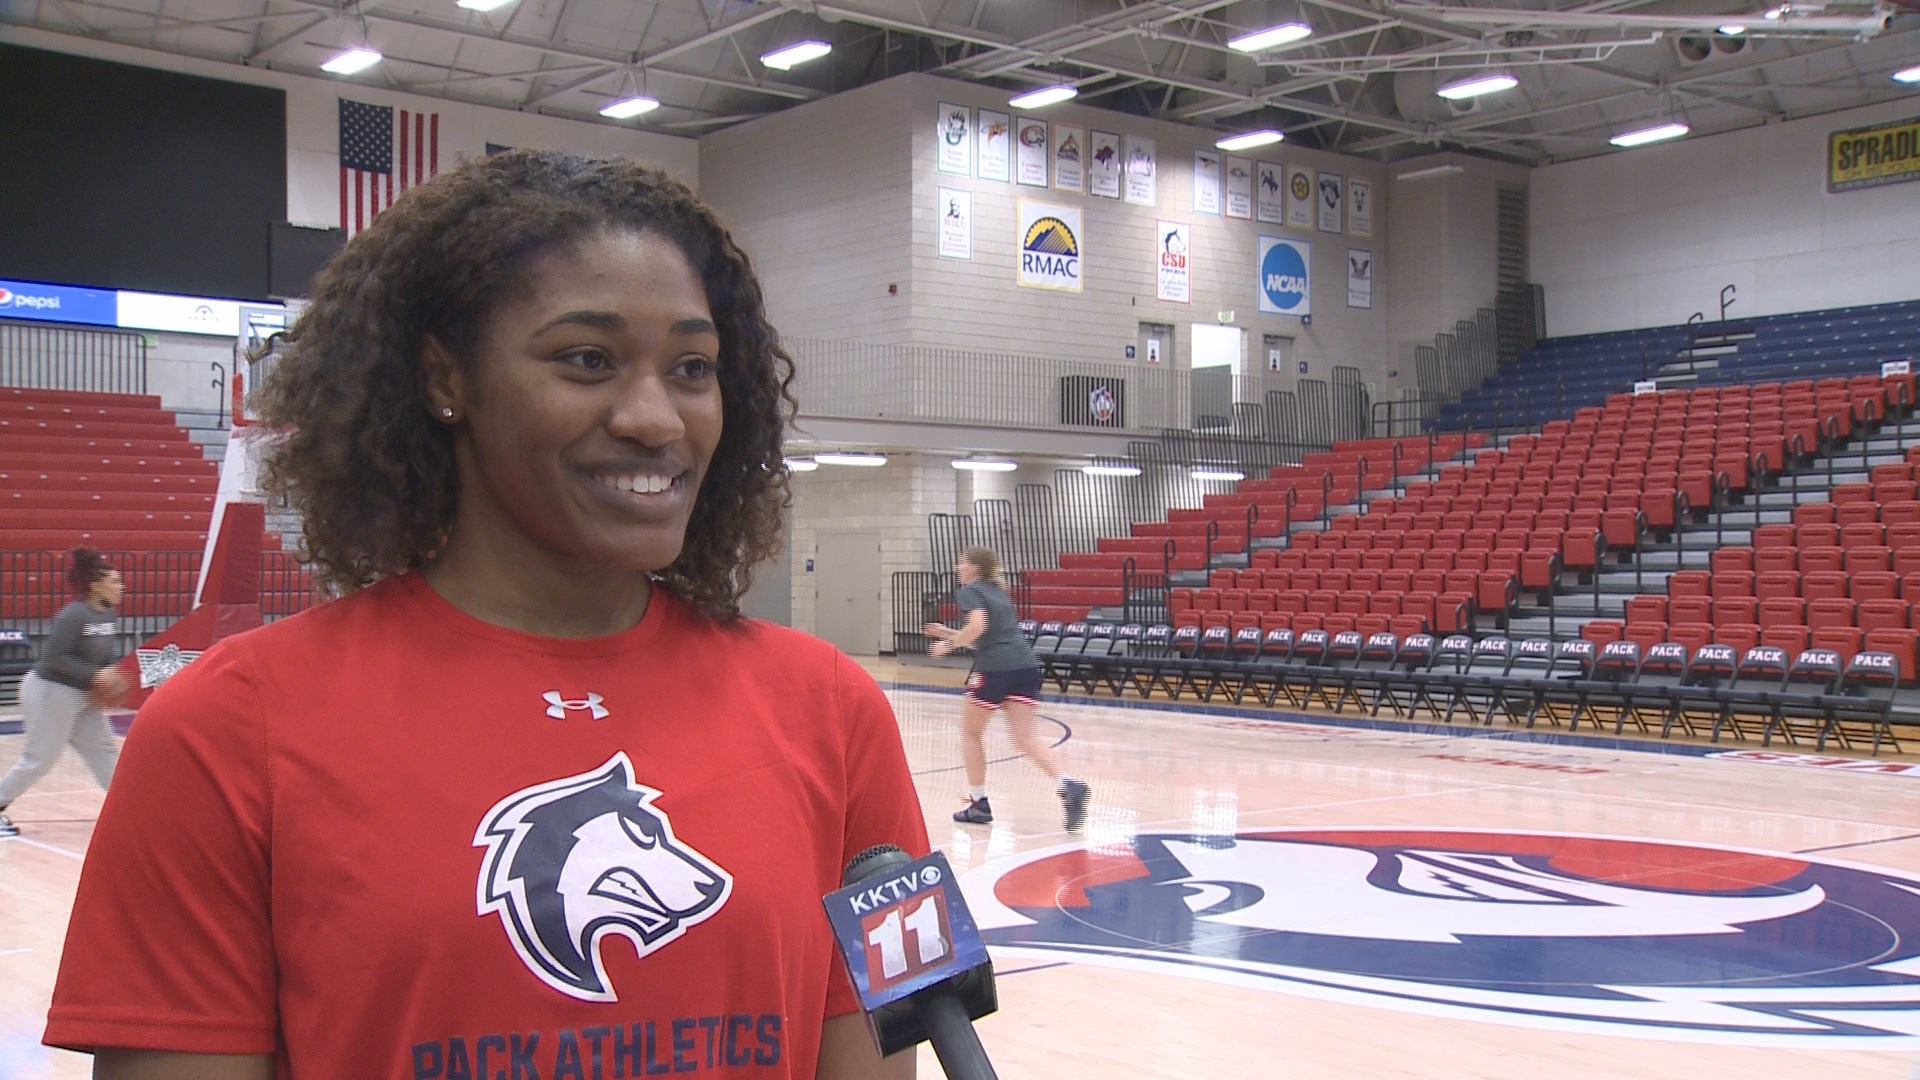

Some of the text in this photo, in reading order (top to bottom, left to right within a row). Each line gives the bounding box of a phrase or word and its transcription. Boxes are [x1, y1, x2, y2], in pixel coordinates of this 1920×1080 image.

[1022, 253, 1078, 278] RMAC
[1161, 252, 1186, 268] CSU
[1266, 273, 1306, 294] NCAA
[15, 294, 61, 310] pepsi
[1018, 622, 1035, 632] ACK
[0, 631, 24, 641] ACK
[1237, 630, 1258, 639] PACK
[1268, 631, 1290, 641] PACK
[1301, 632, 1324, 643] PACK
[1335, 634, 1359, 644] PACK
[1369, 635, 1394, 646] PACK
[1405, 636, 1430, 647] PACK
[1441, 639, 1467, 649] PACK
[1479, 640, 1506, 650] PACK
[1520, 641, 1548, 652] PACK
[1562, 642, 1590, 653] PACK
[1605, 644, 1635, 655] PACK
[1651, 646, 1682, 657] PACK
[1699, 648, 1732, 659] PACK
[1748, 650, 1782, 662] PACK
[1800, 652, 1837, 665] PACK
[1855, 655, 1892, 667] PACK
[849, 871, 918, 915] KKTV
[867, 895, 944, 980] 11
[411, 1013, 781, 1080] PACK ATHLETICS
